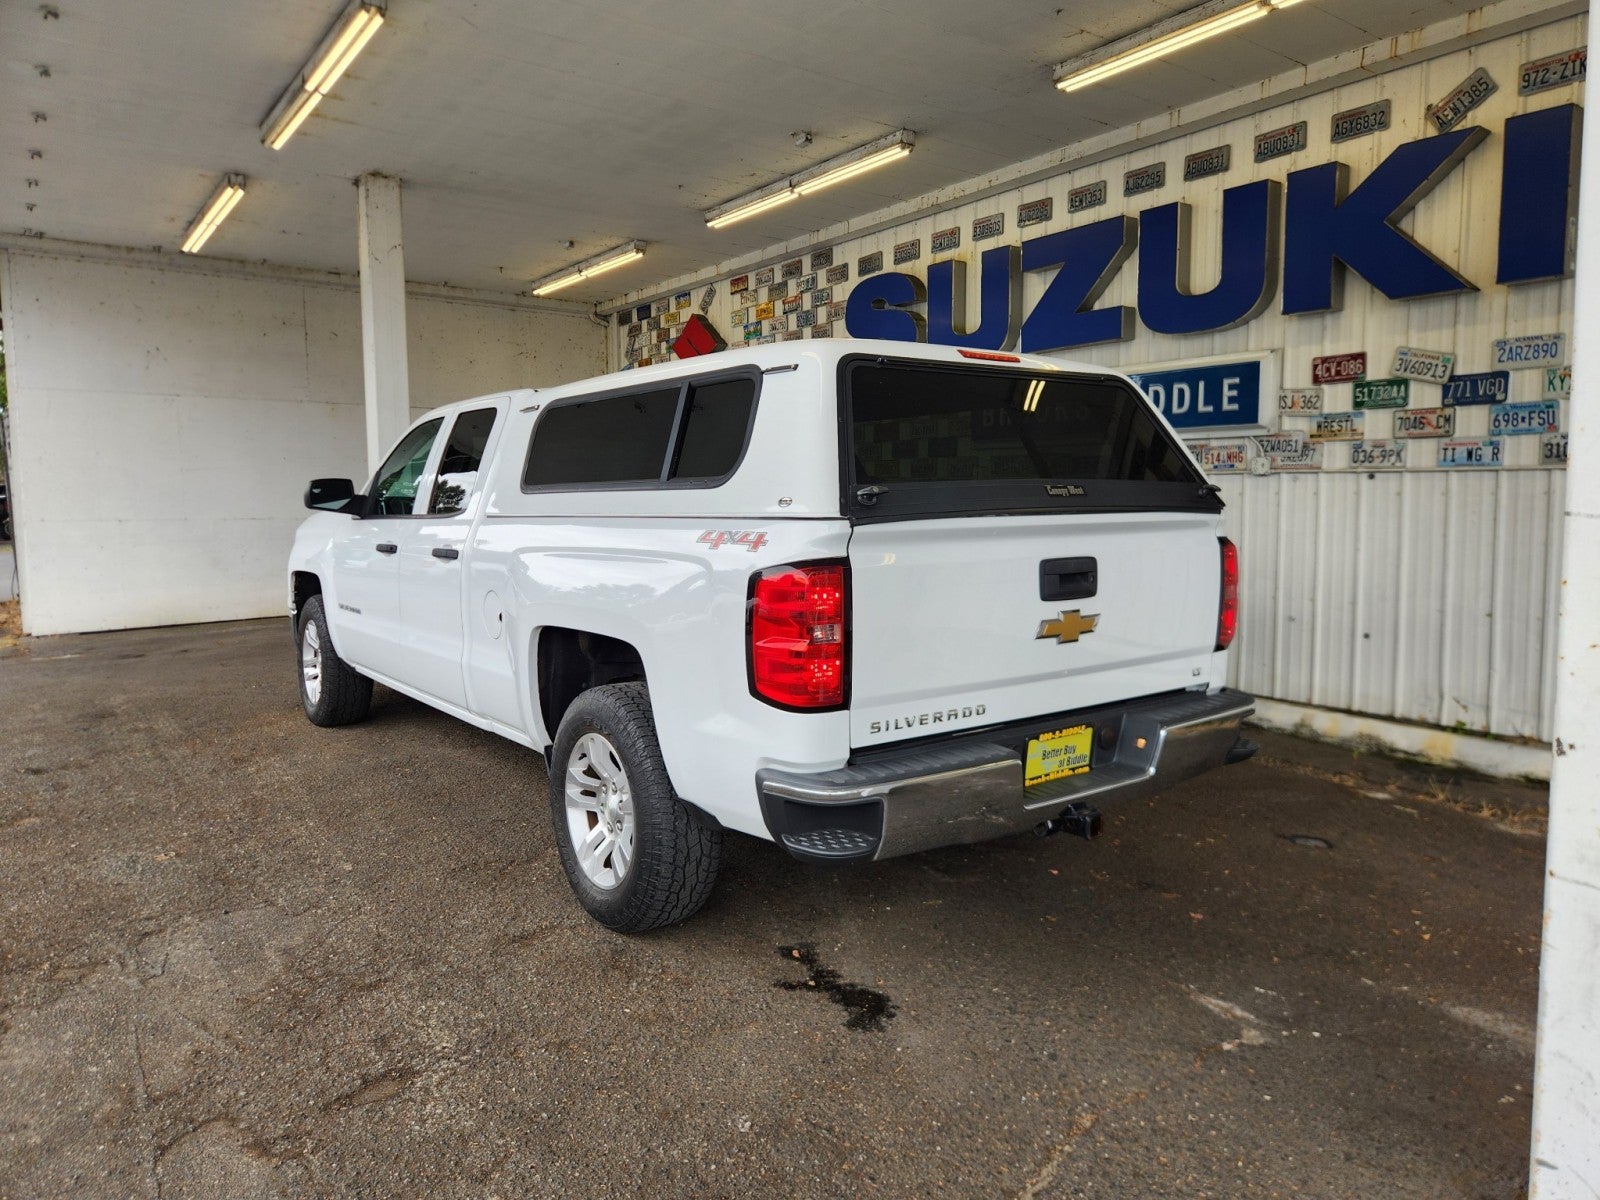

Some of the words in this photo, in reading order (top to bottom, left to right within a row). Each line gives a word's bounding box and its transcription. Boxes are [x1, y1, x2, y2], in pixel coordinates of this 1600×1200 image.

[1333, 110, 1386, 138] AGY6832
[846, 103, 1582, 351] SUZUKI
[1498, 341, 1558, 363] 2ARZ890
[1395, 357, 1448, 381] 3V60913
[870, 704, 987, 734] SILVERADO
[1042, 747, 1063, 761] Better
[1063, 744, 1077, 756] Buy
[1066, 753, 1089, 768] Biddle
